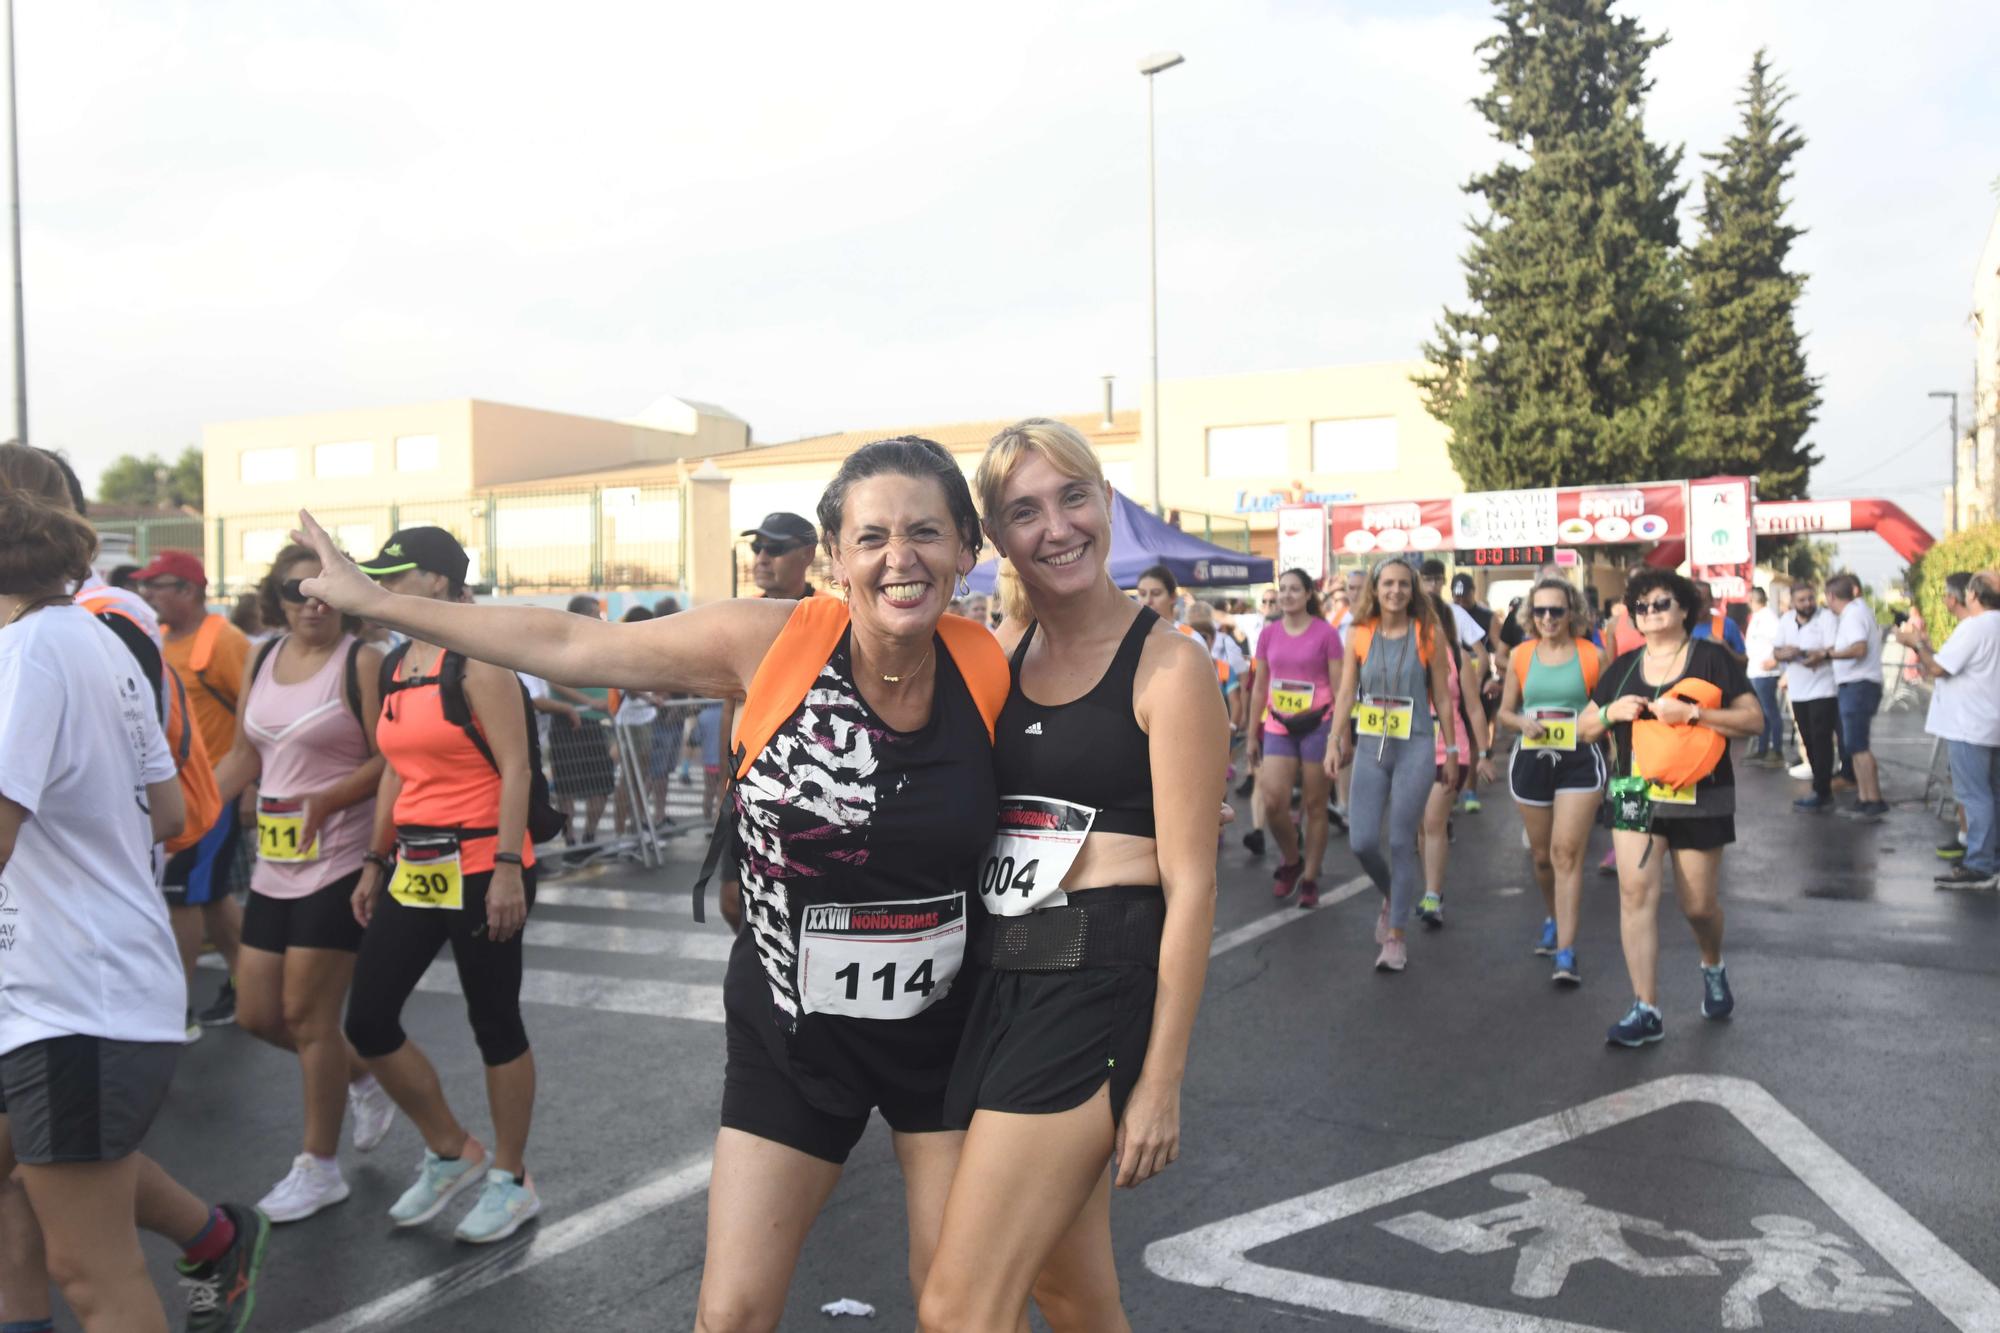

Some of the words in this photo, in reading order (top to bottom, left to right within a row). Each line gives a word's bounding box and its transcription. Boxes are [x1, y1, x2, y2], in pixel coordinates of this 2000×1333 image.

[1362, 504, 1421, 530] PAMU
[1578, 493, 1644, 518] PAMU
[981, 856, 1039, 898] 004
[808, 908, 850, 930] XXVIII
[851, 911, 939, 930] NONDUERMAS
[835, 958, 936, 1001] 114
